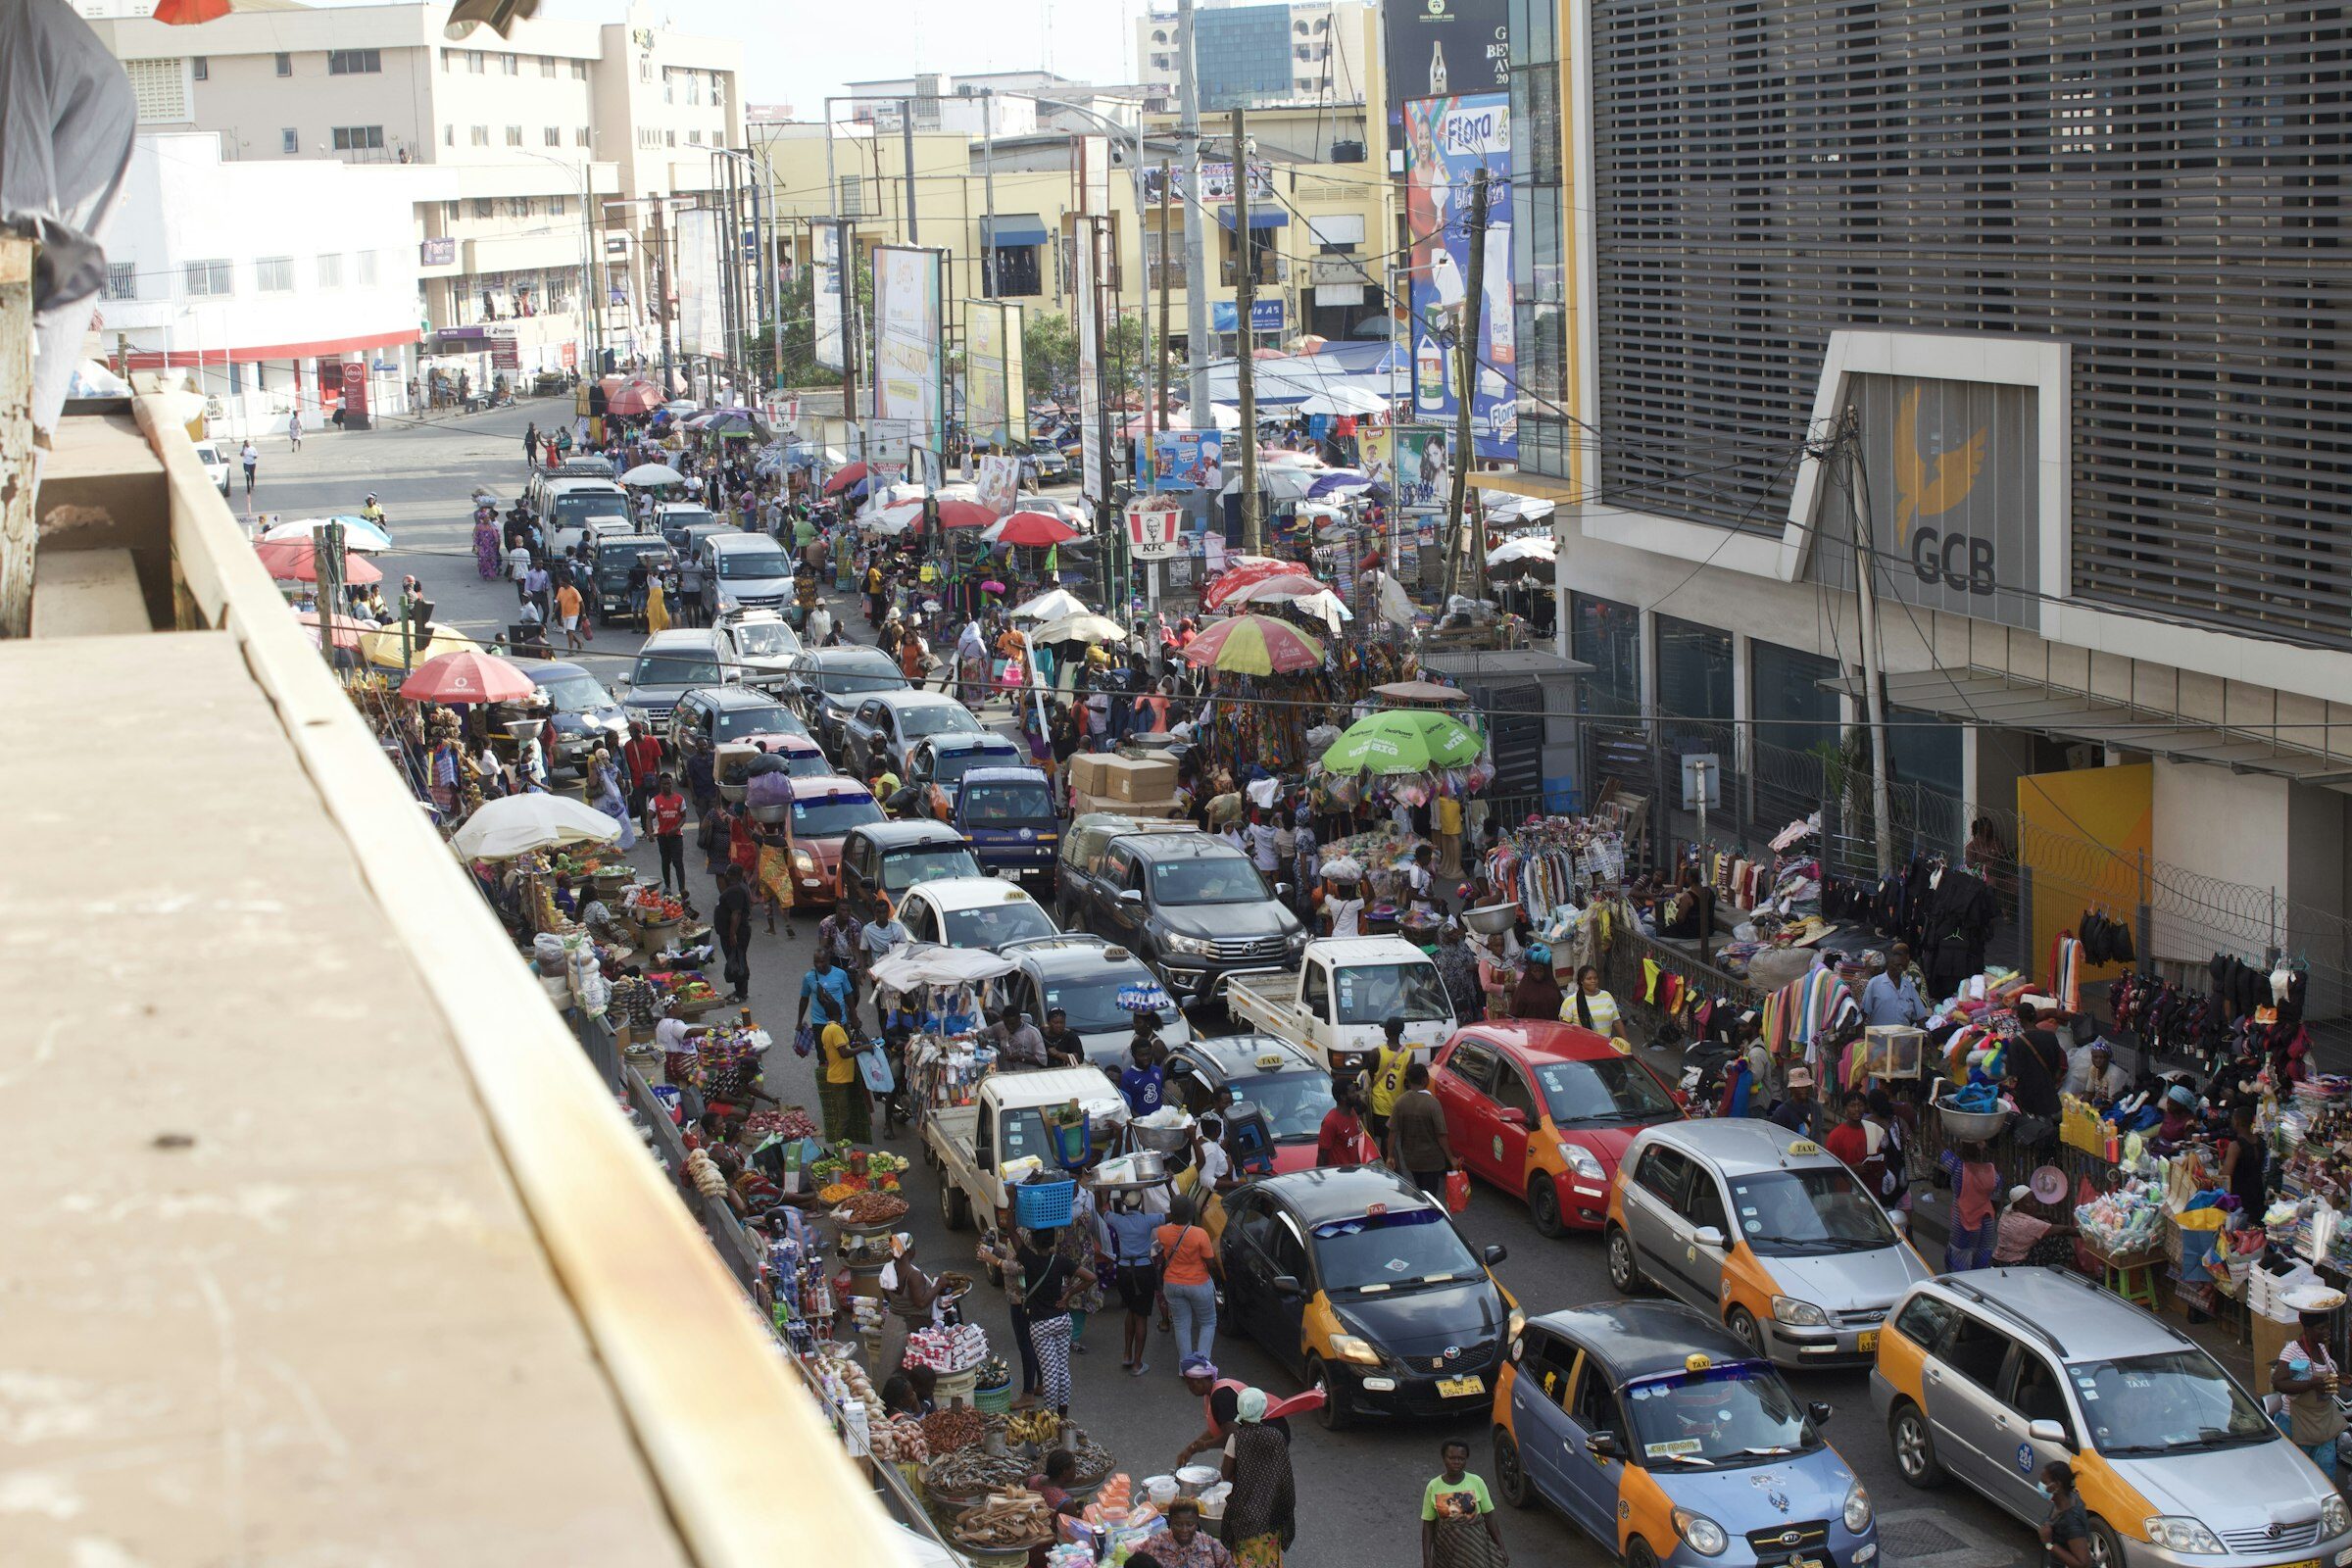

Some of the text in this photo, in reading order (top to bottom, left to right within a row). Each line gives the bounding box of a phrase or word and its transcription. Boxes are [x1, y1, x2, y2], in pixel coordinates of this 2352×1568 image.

[1448, 113, 1492, 150] Flora
[1143, 543, 1166, 552] KFC
[1911, 525, 1996, 596] GCB
[1348, 743, 1398, 758] WIN BIG
[1444, 733, 1467, 752] WIN
[1613, 1039, 1625, 1049] TAXI
[1386, 1073, 1396, 1091] 6
[1144, 1083, 1158, 1103] 3
[1692, 1360, 1709, 1369] TAXI
[2019, 1449, 2032, 1468] 224
[1785, 1535, 1798, 1544] KIA
